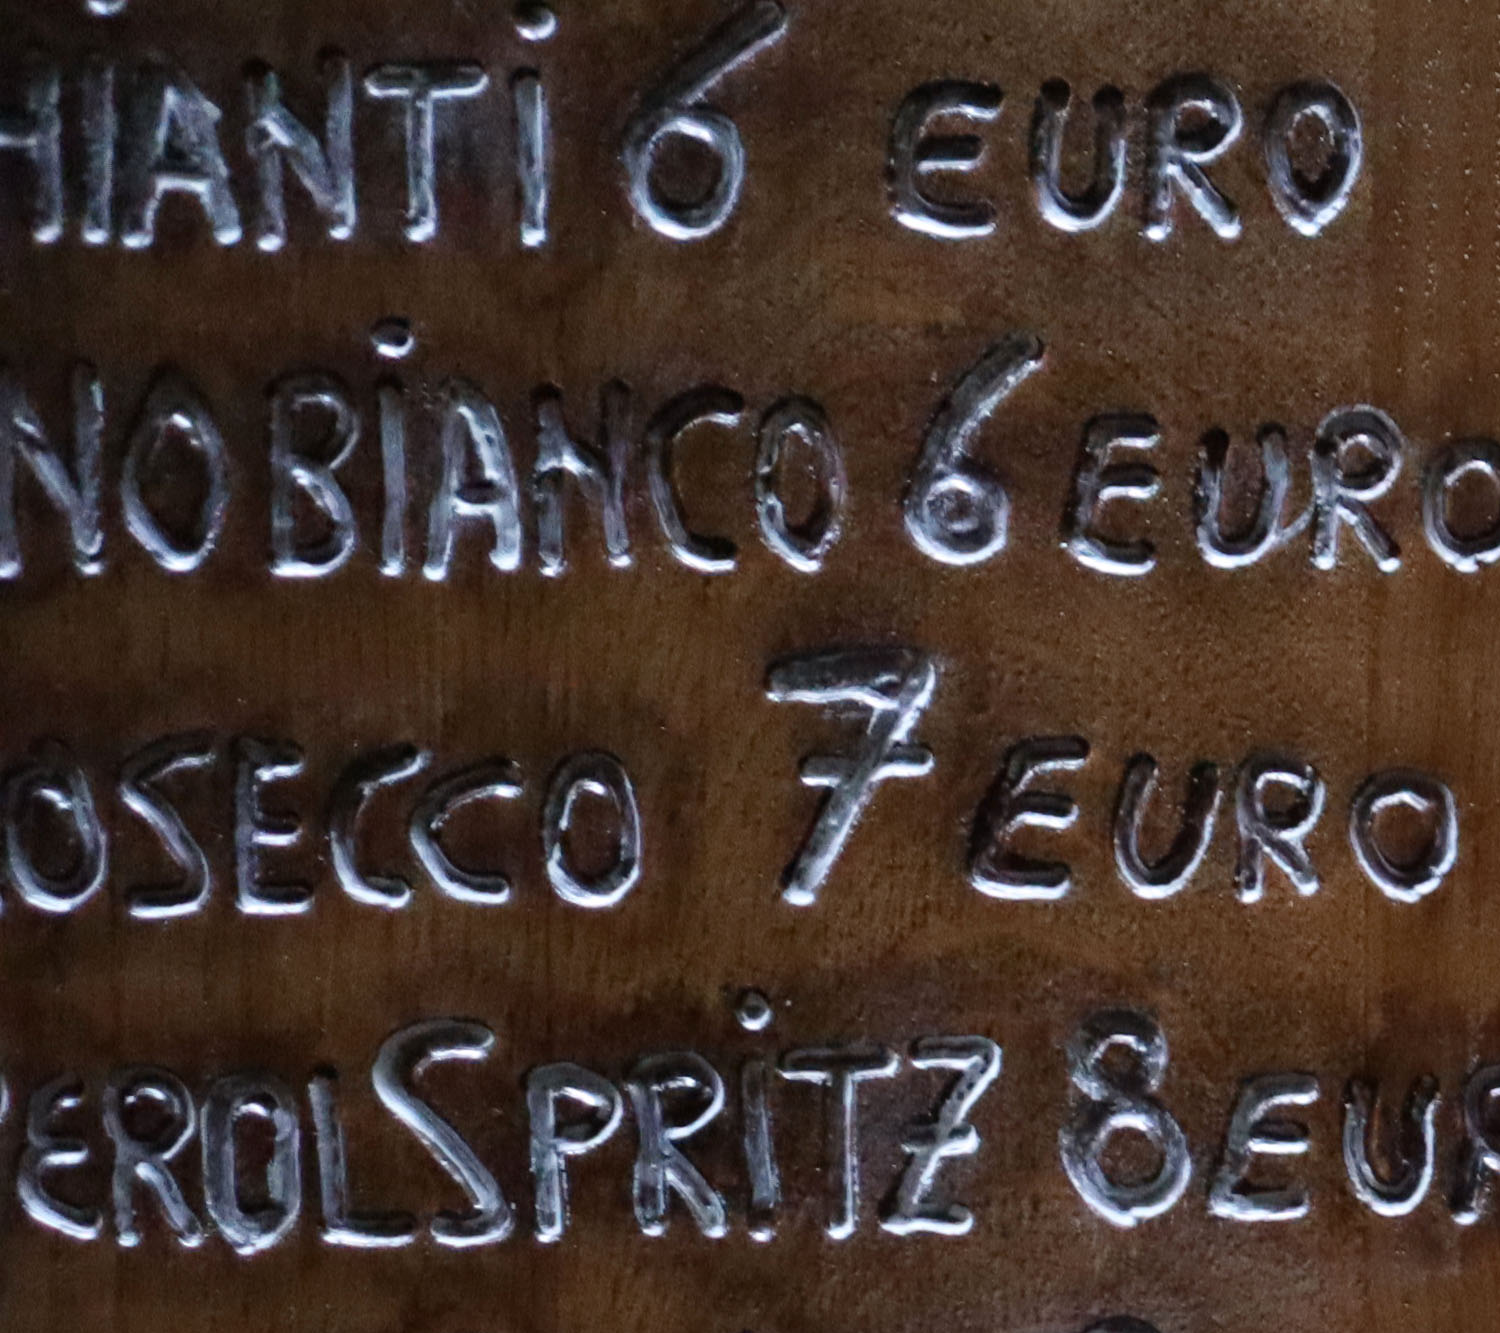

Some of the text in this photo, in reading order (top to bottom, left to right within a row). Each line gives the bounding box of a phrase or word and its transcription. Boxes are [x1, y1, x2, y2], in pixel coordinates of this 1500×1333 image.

[622, 0, 790, 241] 6
[886, 72, 1364, 241] EURO
[904, 332, 1046, 567] 6
[764, 644, 938, 908] 7
[966, 734, 1460, 905] EURO
[0, 986, 1003, 1254] EROLSPRITZ
[1060, 1006, 1193, 1228] 8
